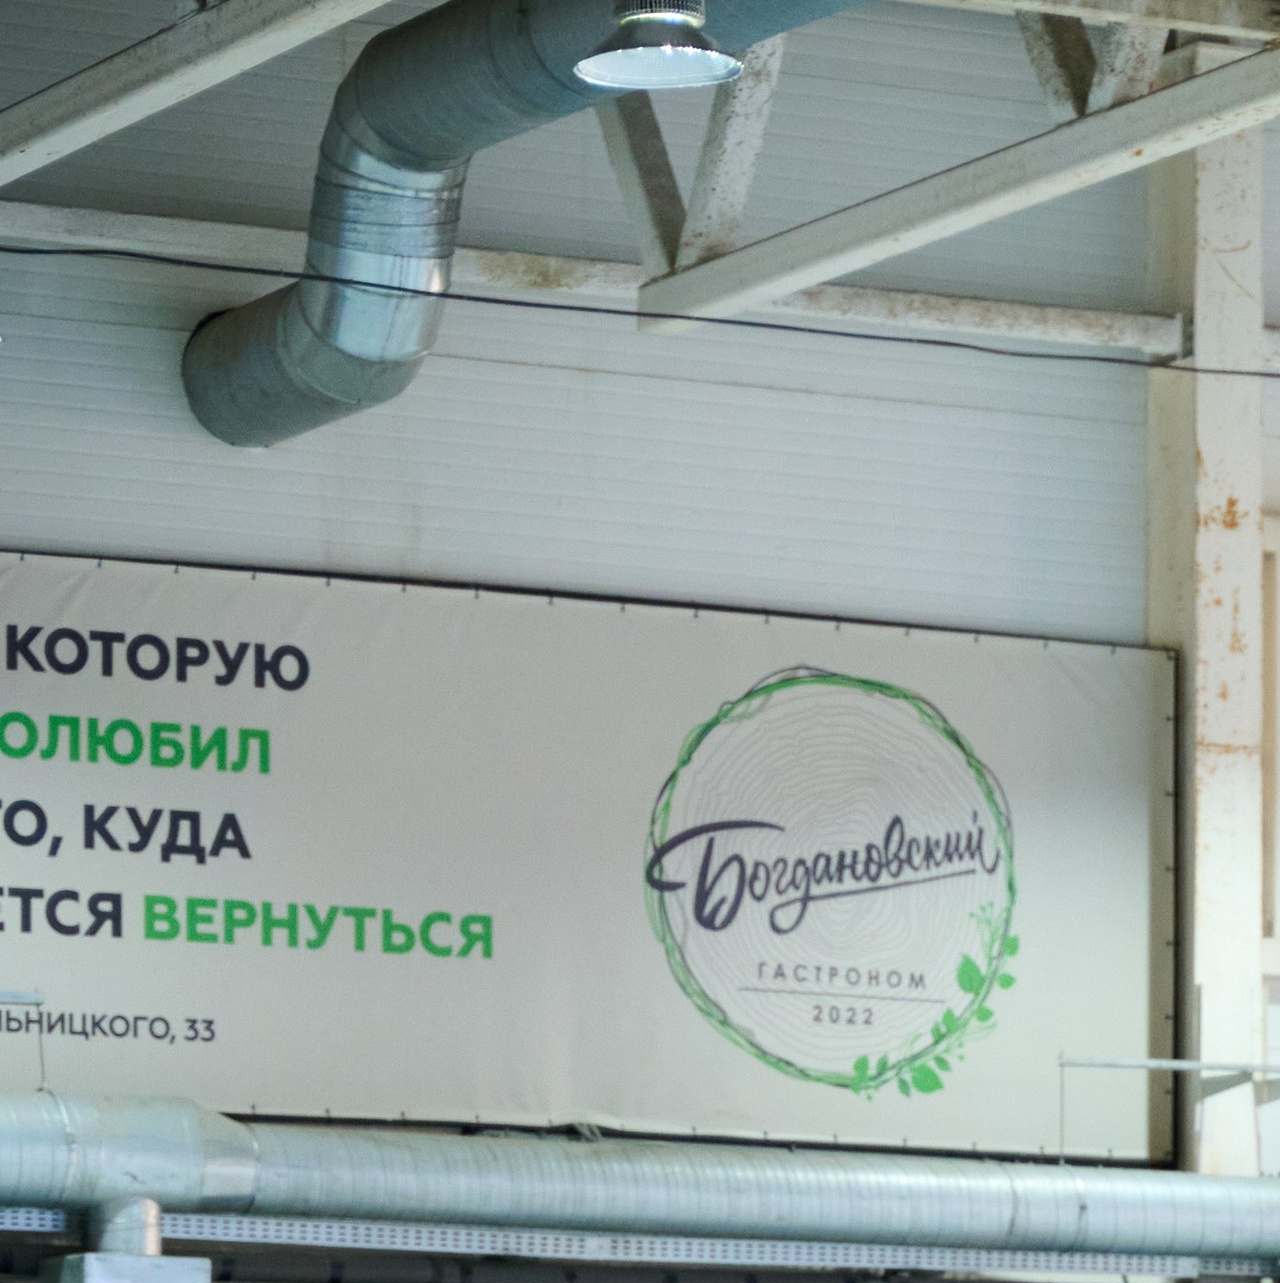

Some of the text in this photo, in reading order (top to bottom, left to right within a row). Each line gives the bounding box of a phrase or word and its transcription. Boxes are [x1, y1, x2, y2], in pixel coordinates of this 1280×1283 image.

[6, 624, 310, 691] КОТОРУЮ
[0, 711, 270, 774] ОЛЮБИЛ
[0, 799, 252, 864] О, КУДА
[646, 809, 1001, 935] Богдановский
[0, 886, 494, 959] ТСЯ ВЕРНУТЬСЯ
[757, 962, 927, 990] ГАСТРОНОМ
[183, 1018, 215, 1042] 33
[812, 1005, 874, 1026] 2022
